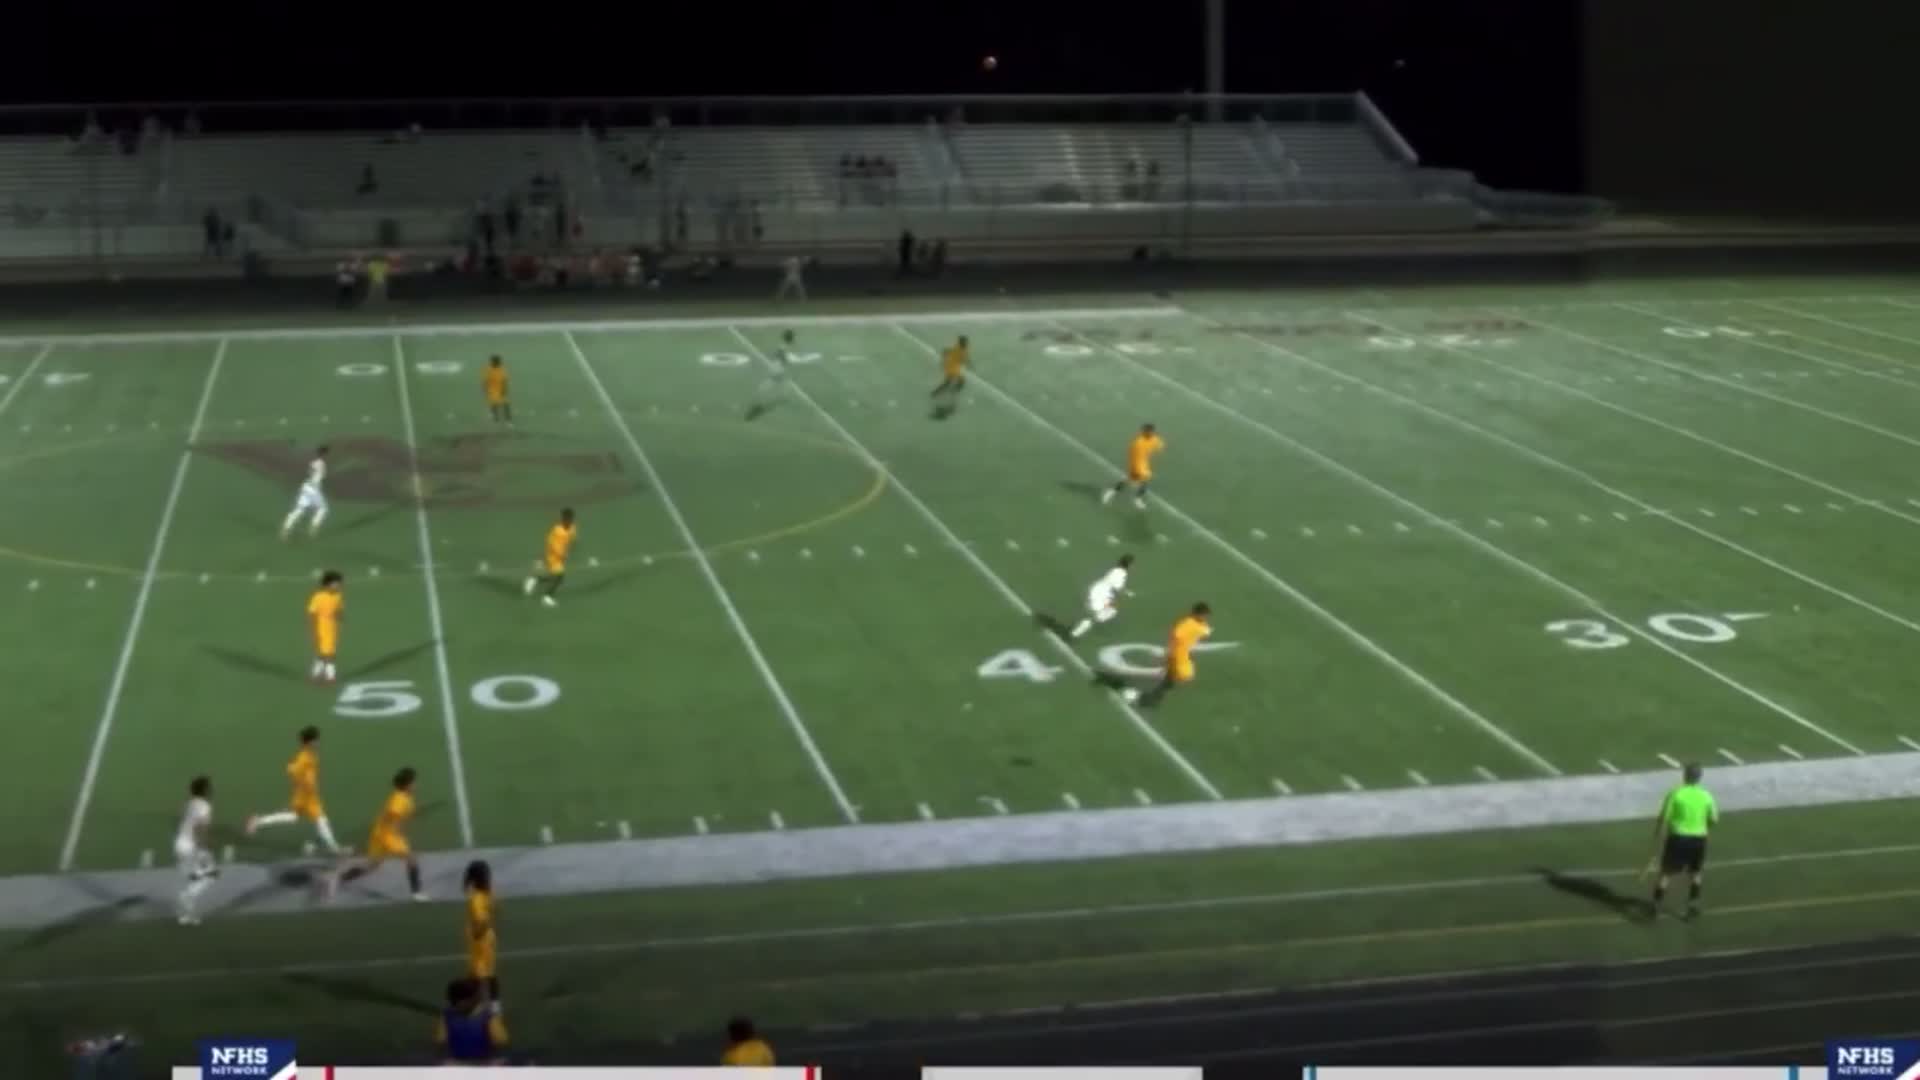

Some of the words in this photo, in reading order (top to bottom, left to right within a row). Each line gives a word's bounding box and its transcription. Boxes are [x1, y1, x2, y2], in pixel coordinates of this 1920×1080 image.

[1544, 613, 1737, 649] 30
[977, 643, 1168, 682] 40
[333, 674, 560, 717] 50
